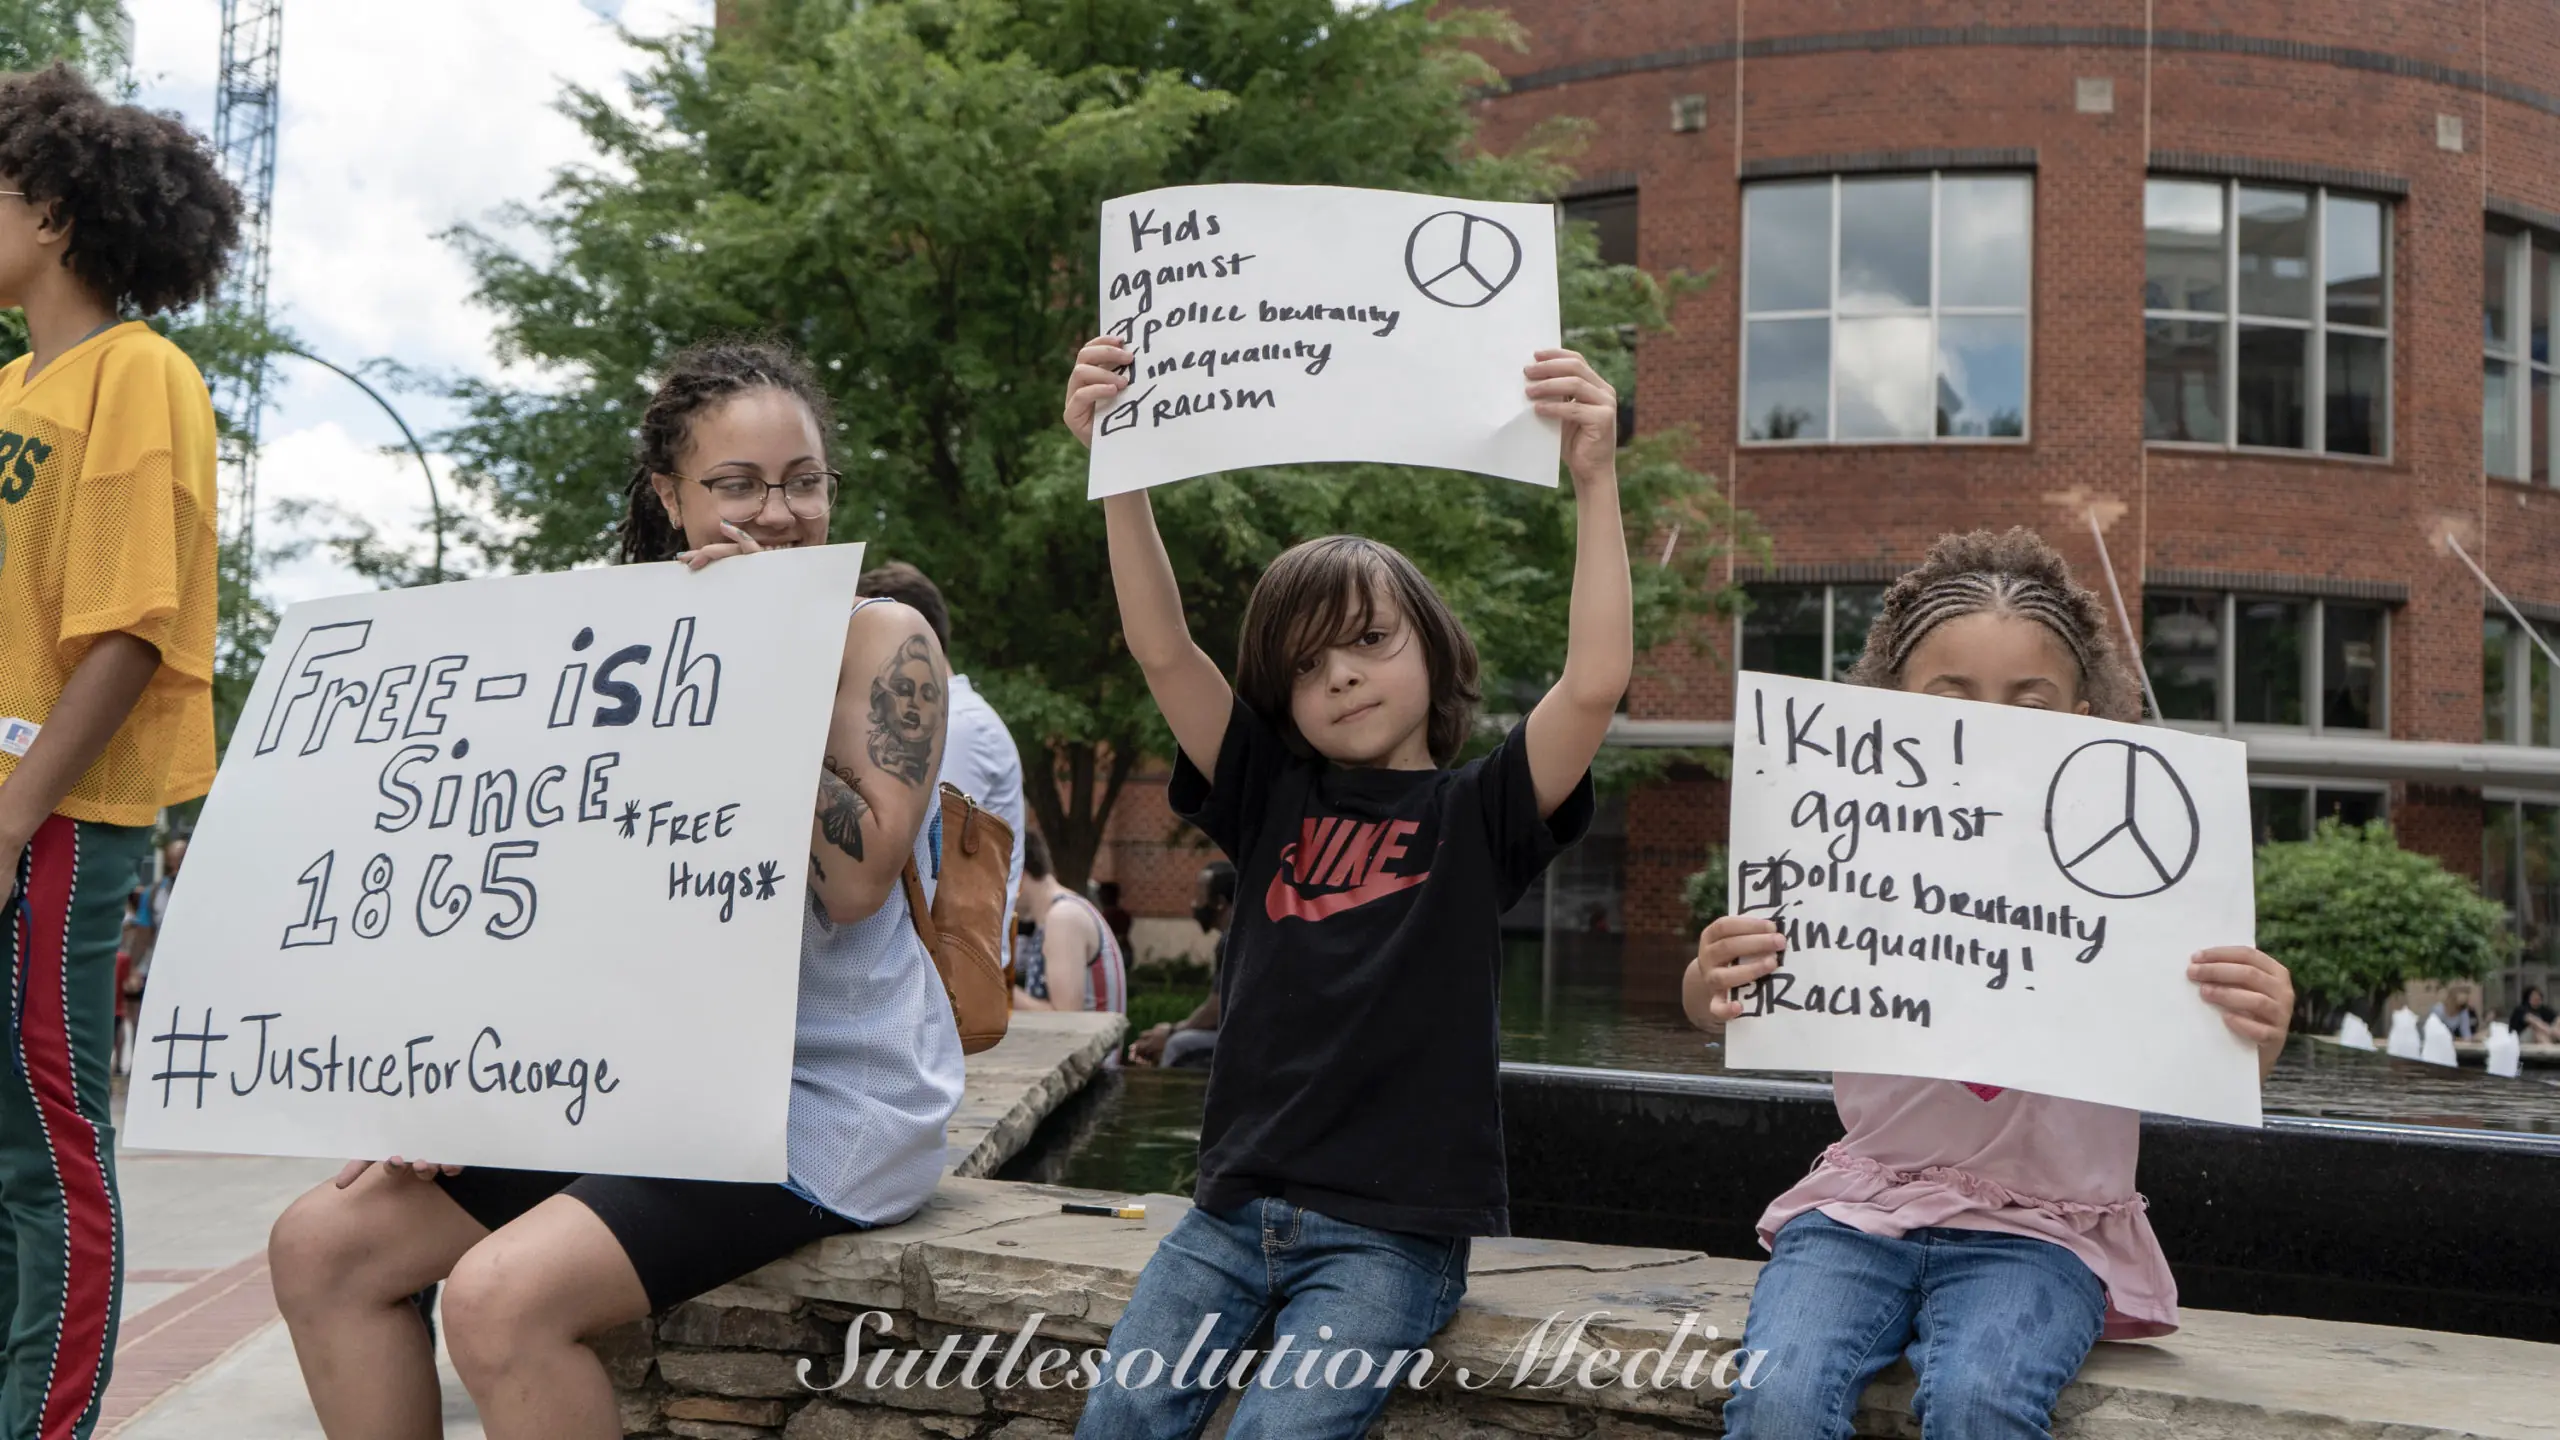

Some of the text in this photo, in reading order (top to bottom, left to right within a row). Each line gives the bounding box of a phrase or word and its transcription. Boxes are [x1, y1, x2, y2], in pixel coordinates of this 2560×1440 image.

[1130, 208, 1221, 253] Kids
[1109, 252, 1256, 313] against
[1142, 300, 1400, 353] police brutality
[1294, 817, 1421, 887] NIKE
[1790, 790, 2003, 862] against
[280, 841, 539, 950] 1865
[1913, 873, 2107, 963] brutality
